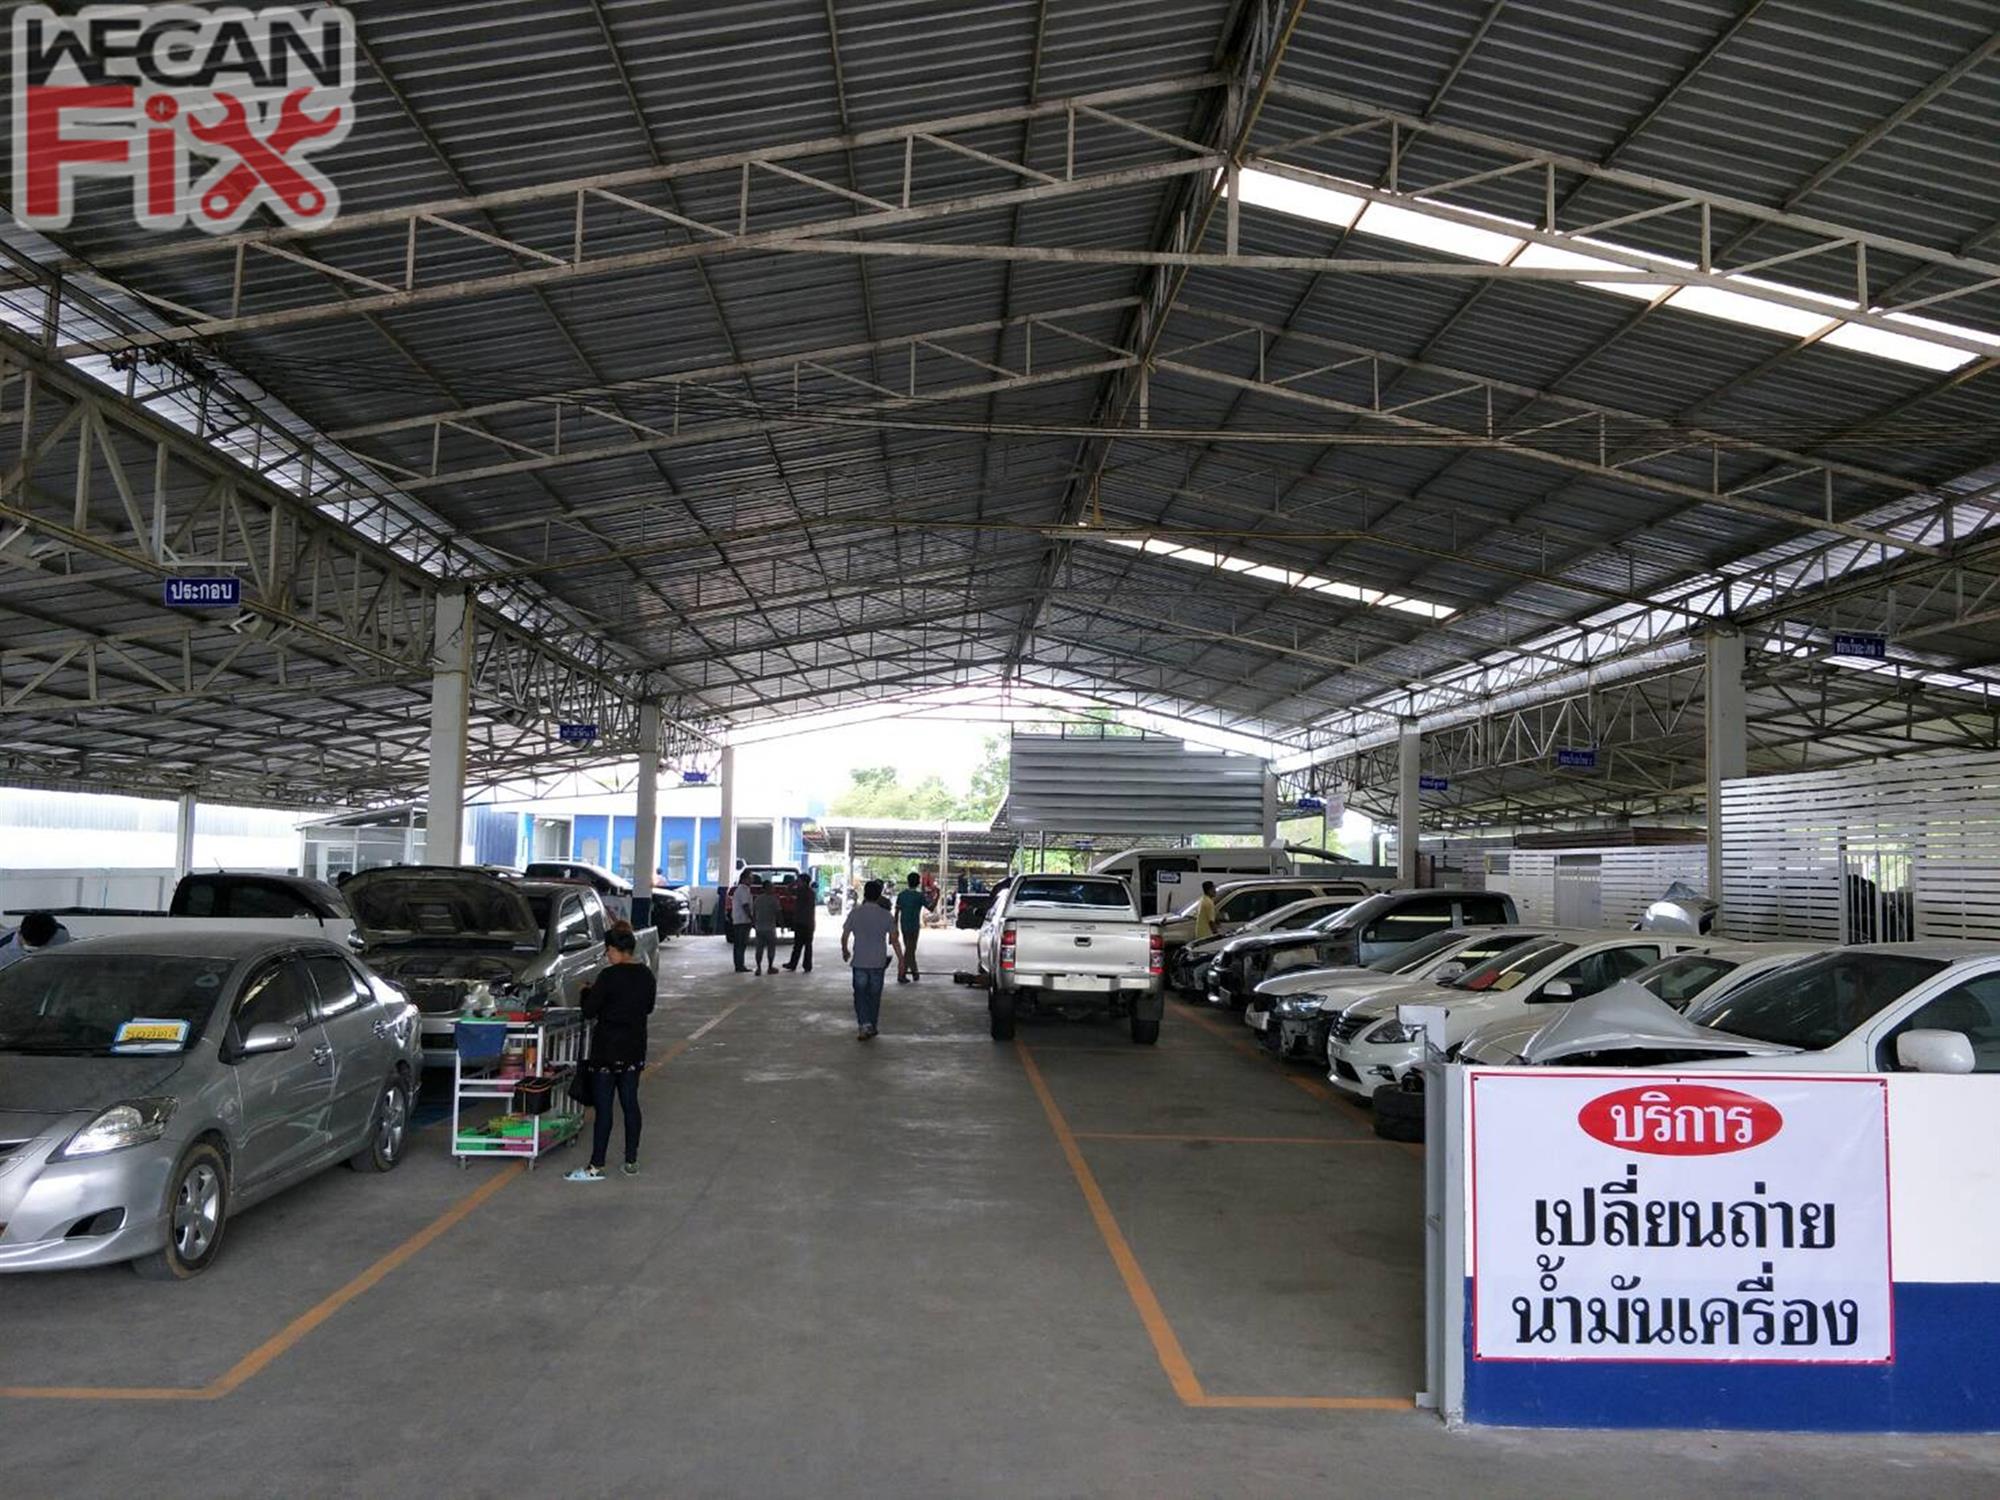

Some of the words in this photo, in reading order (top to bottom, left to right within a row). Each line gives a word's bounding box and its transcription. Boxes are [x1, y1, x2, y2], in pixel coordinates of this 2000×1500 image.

[170, 580, 233, 600] ประกอบ
[1610, 1091, 1753, 1144] บริการ
[1534, 1164, 1836, 1249] เปลี่ยนถ่าย
[1511, 1253, 1859, 1347] น้ำมันเครื่อง
